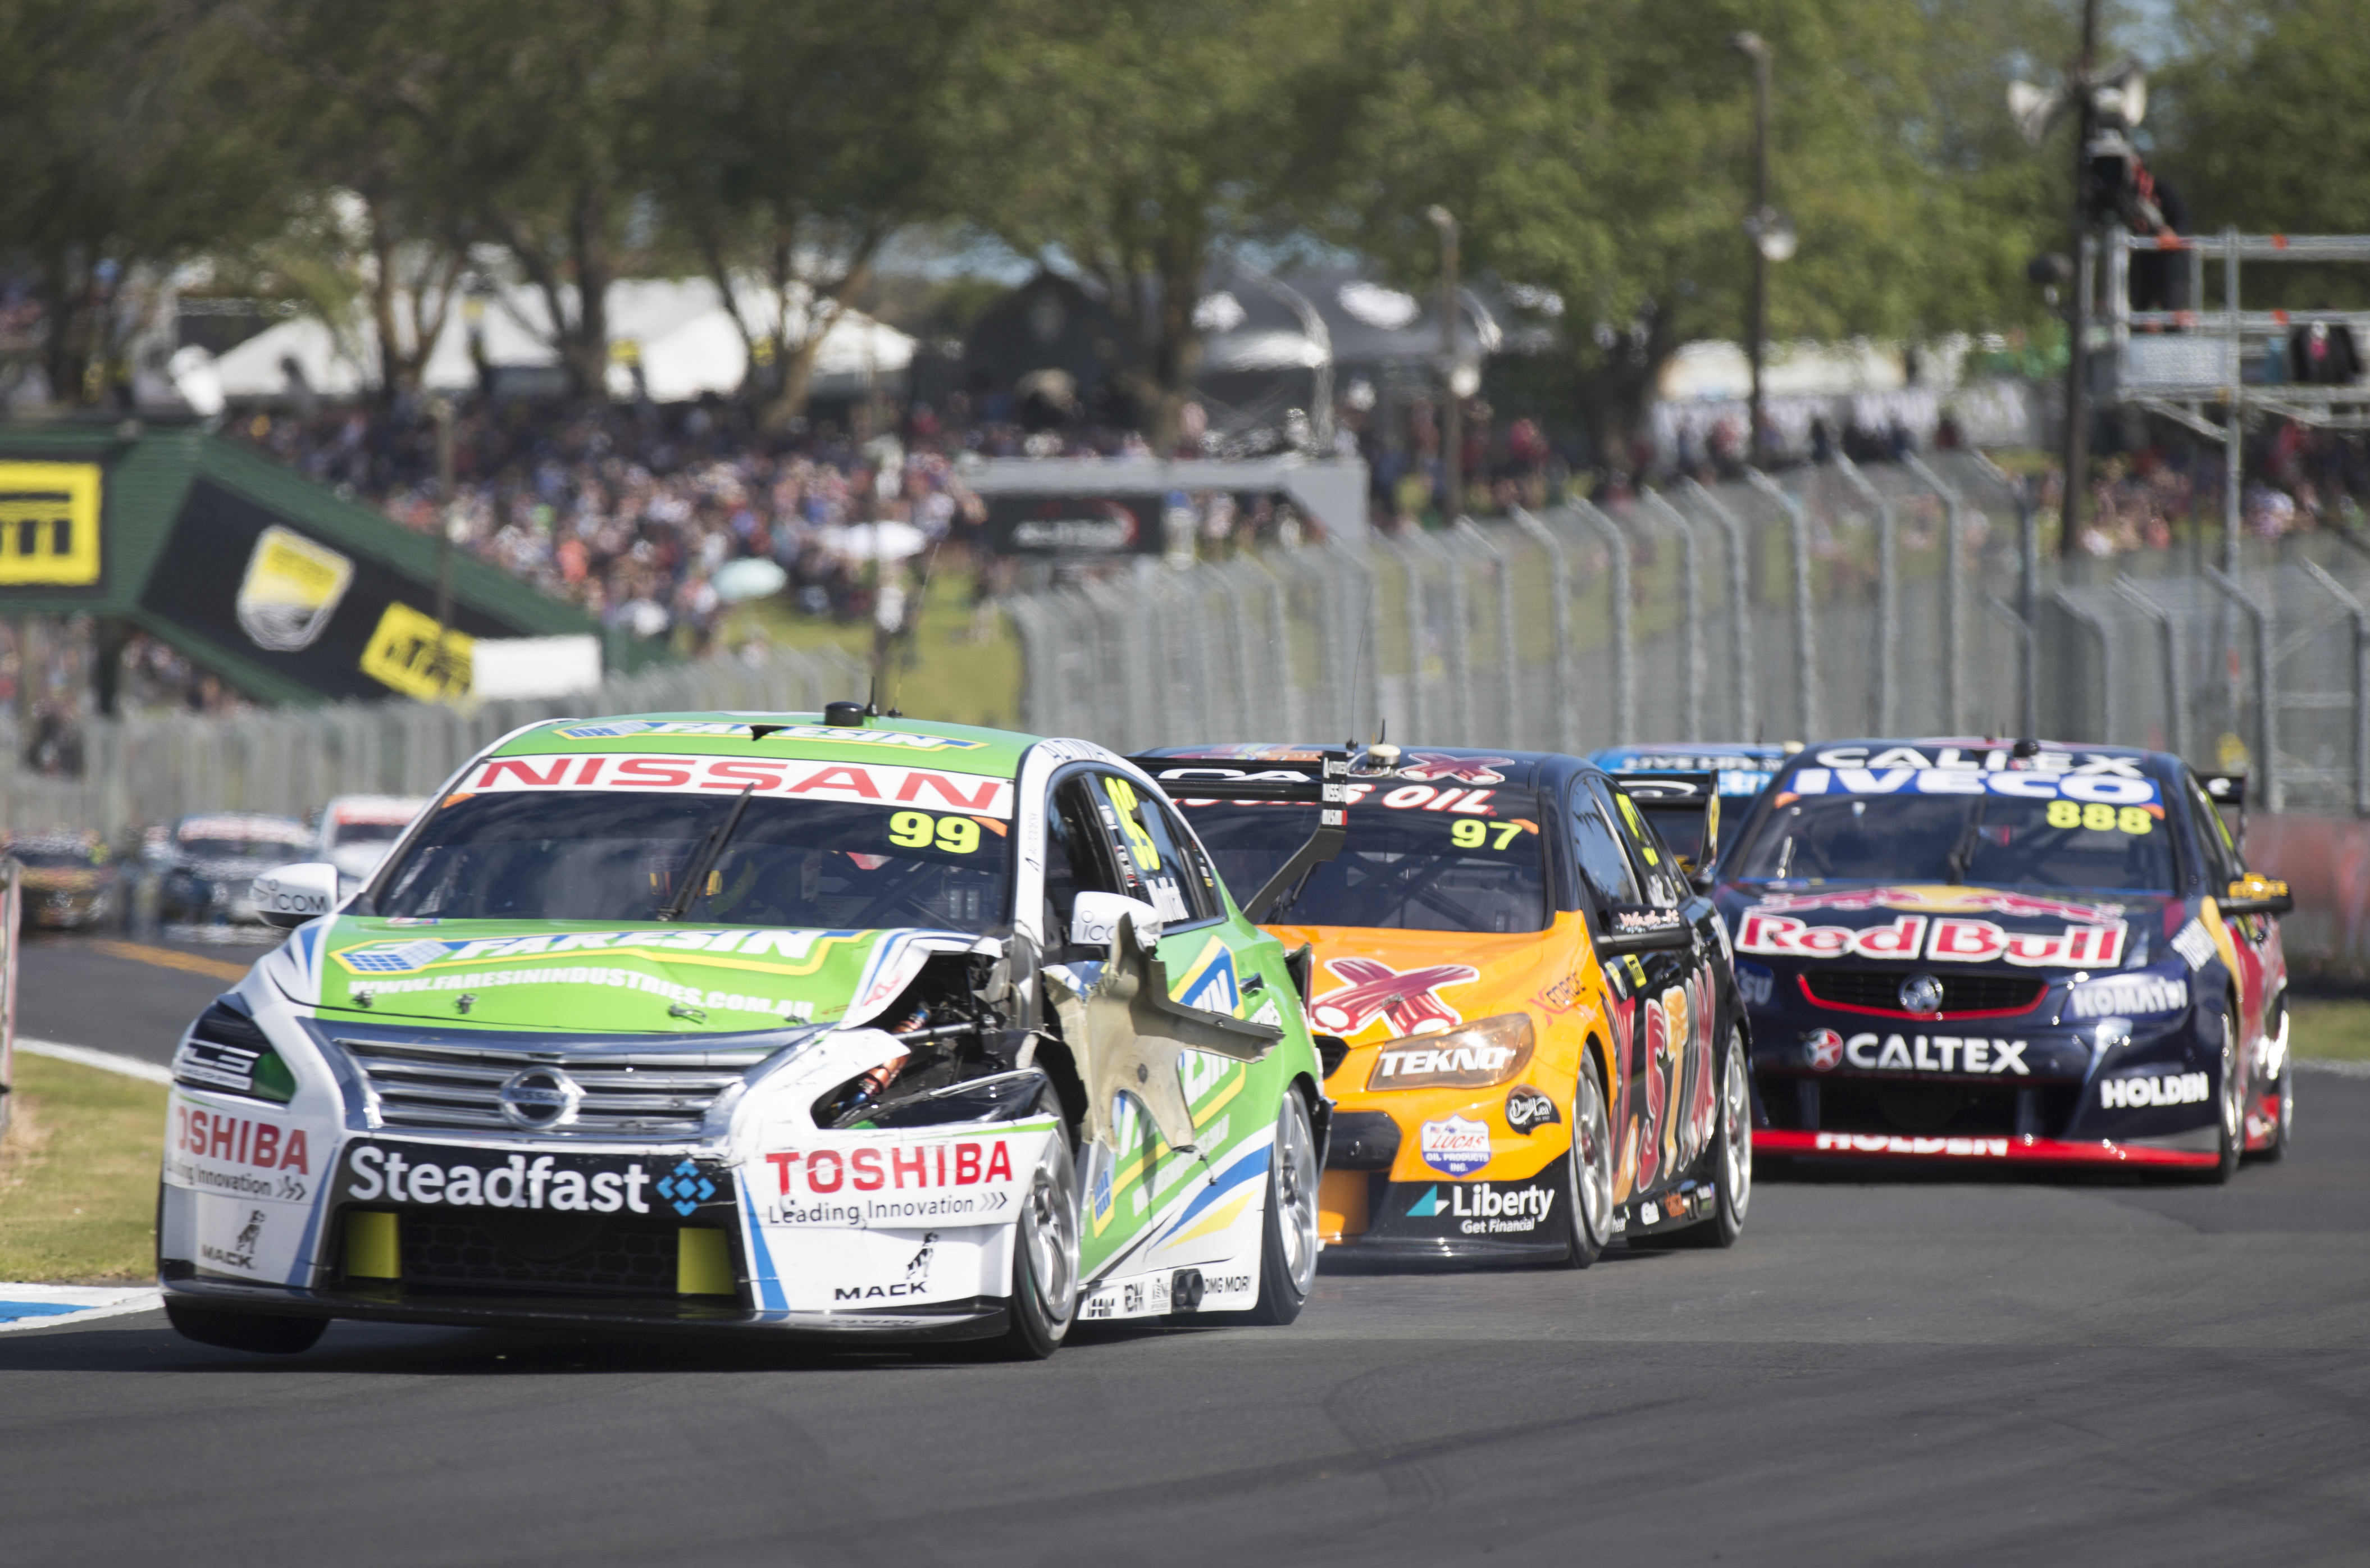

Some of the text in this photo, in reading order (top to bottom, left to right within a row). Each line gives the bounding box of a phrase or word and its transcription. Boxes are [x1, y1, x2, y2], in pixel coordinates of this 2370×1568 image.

[476, 757, 1001, 810] NISSAN
[1793, 768, 2154, 804] IVECO
[1382, 785, 1492, 815] OIL
[889, 811, 981, 854] 99
[2046, 800, 2153, 835] 888
[1451, 819, 1524, 850] 97
[447, 930, 828, 960] FARESIN
[1379, 1047, 1508, 1077] TEKNO
[1844, 1032, 2031, 1075] CALTEX
[2100, 1071, 2209, 1109] HOLDEN
[1426, 1152, 1490, 1163] OIL PRODUCTS
[1430, 1135, 1485, 1149] LUCAS
[348, 1146, 650, 1214] Steadfast
[765, 1140, 1013, 1196] TOSHIBA
[769, 1195, 974, 1225] Leading Innovation
[1453, 1183, 1555, 1222] Liberty
[1461, 1216, 1535, 1234] Get Financial
[200, 1244, 256, 1271] MACK
[835, 1280, 927, 1301] MACK
